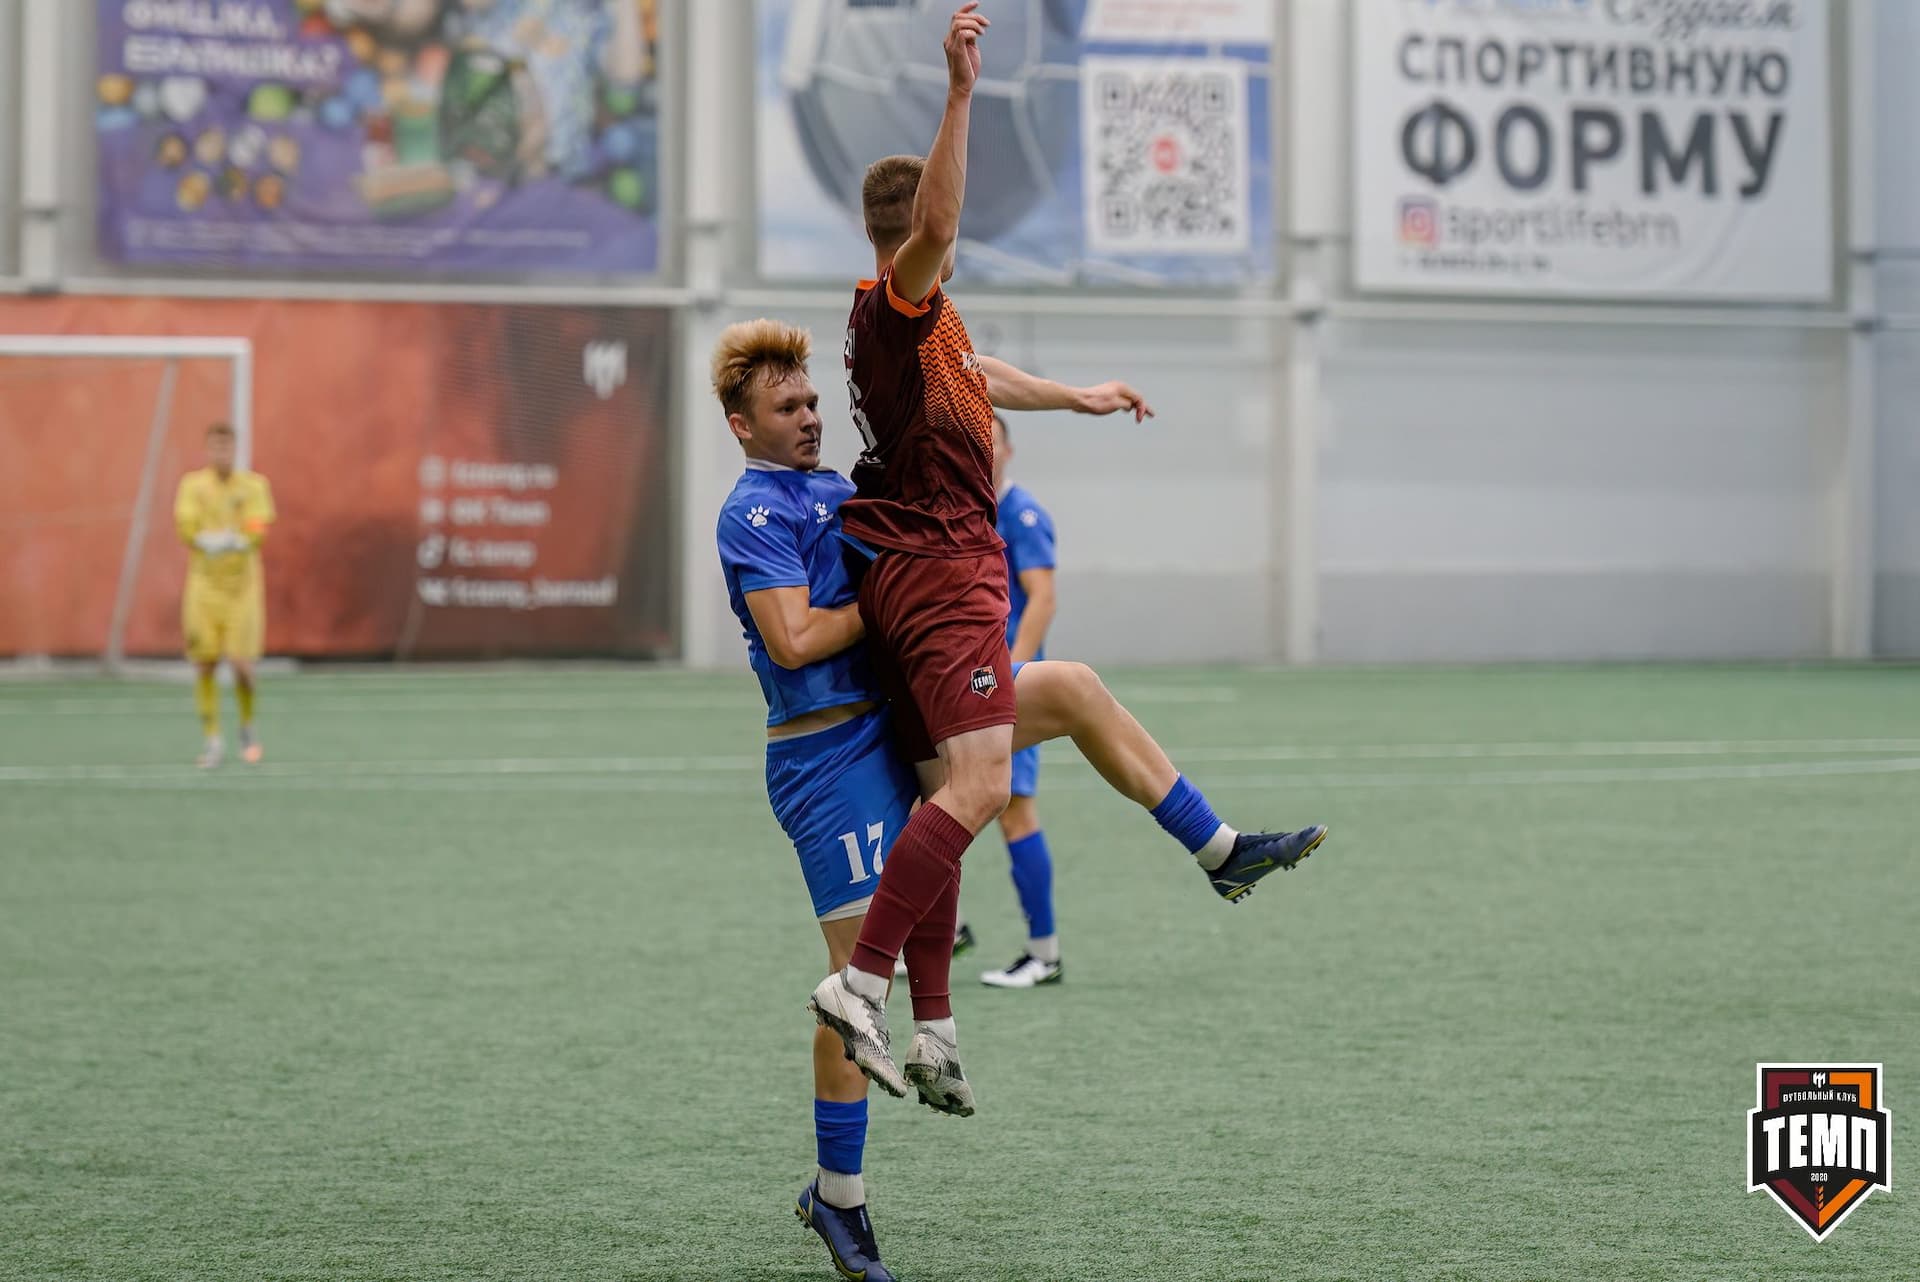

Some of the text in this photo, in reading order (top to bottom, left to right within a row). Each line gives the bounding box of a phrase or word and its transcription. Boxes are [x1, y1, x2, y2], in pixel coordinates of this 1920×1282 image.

[1398, 32, 1791, 97] СПОРТИВНУЮ
[1400, 98, 1785, 200] ФОРМУ
[838, 821, 884, 884] 17
